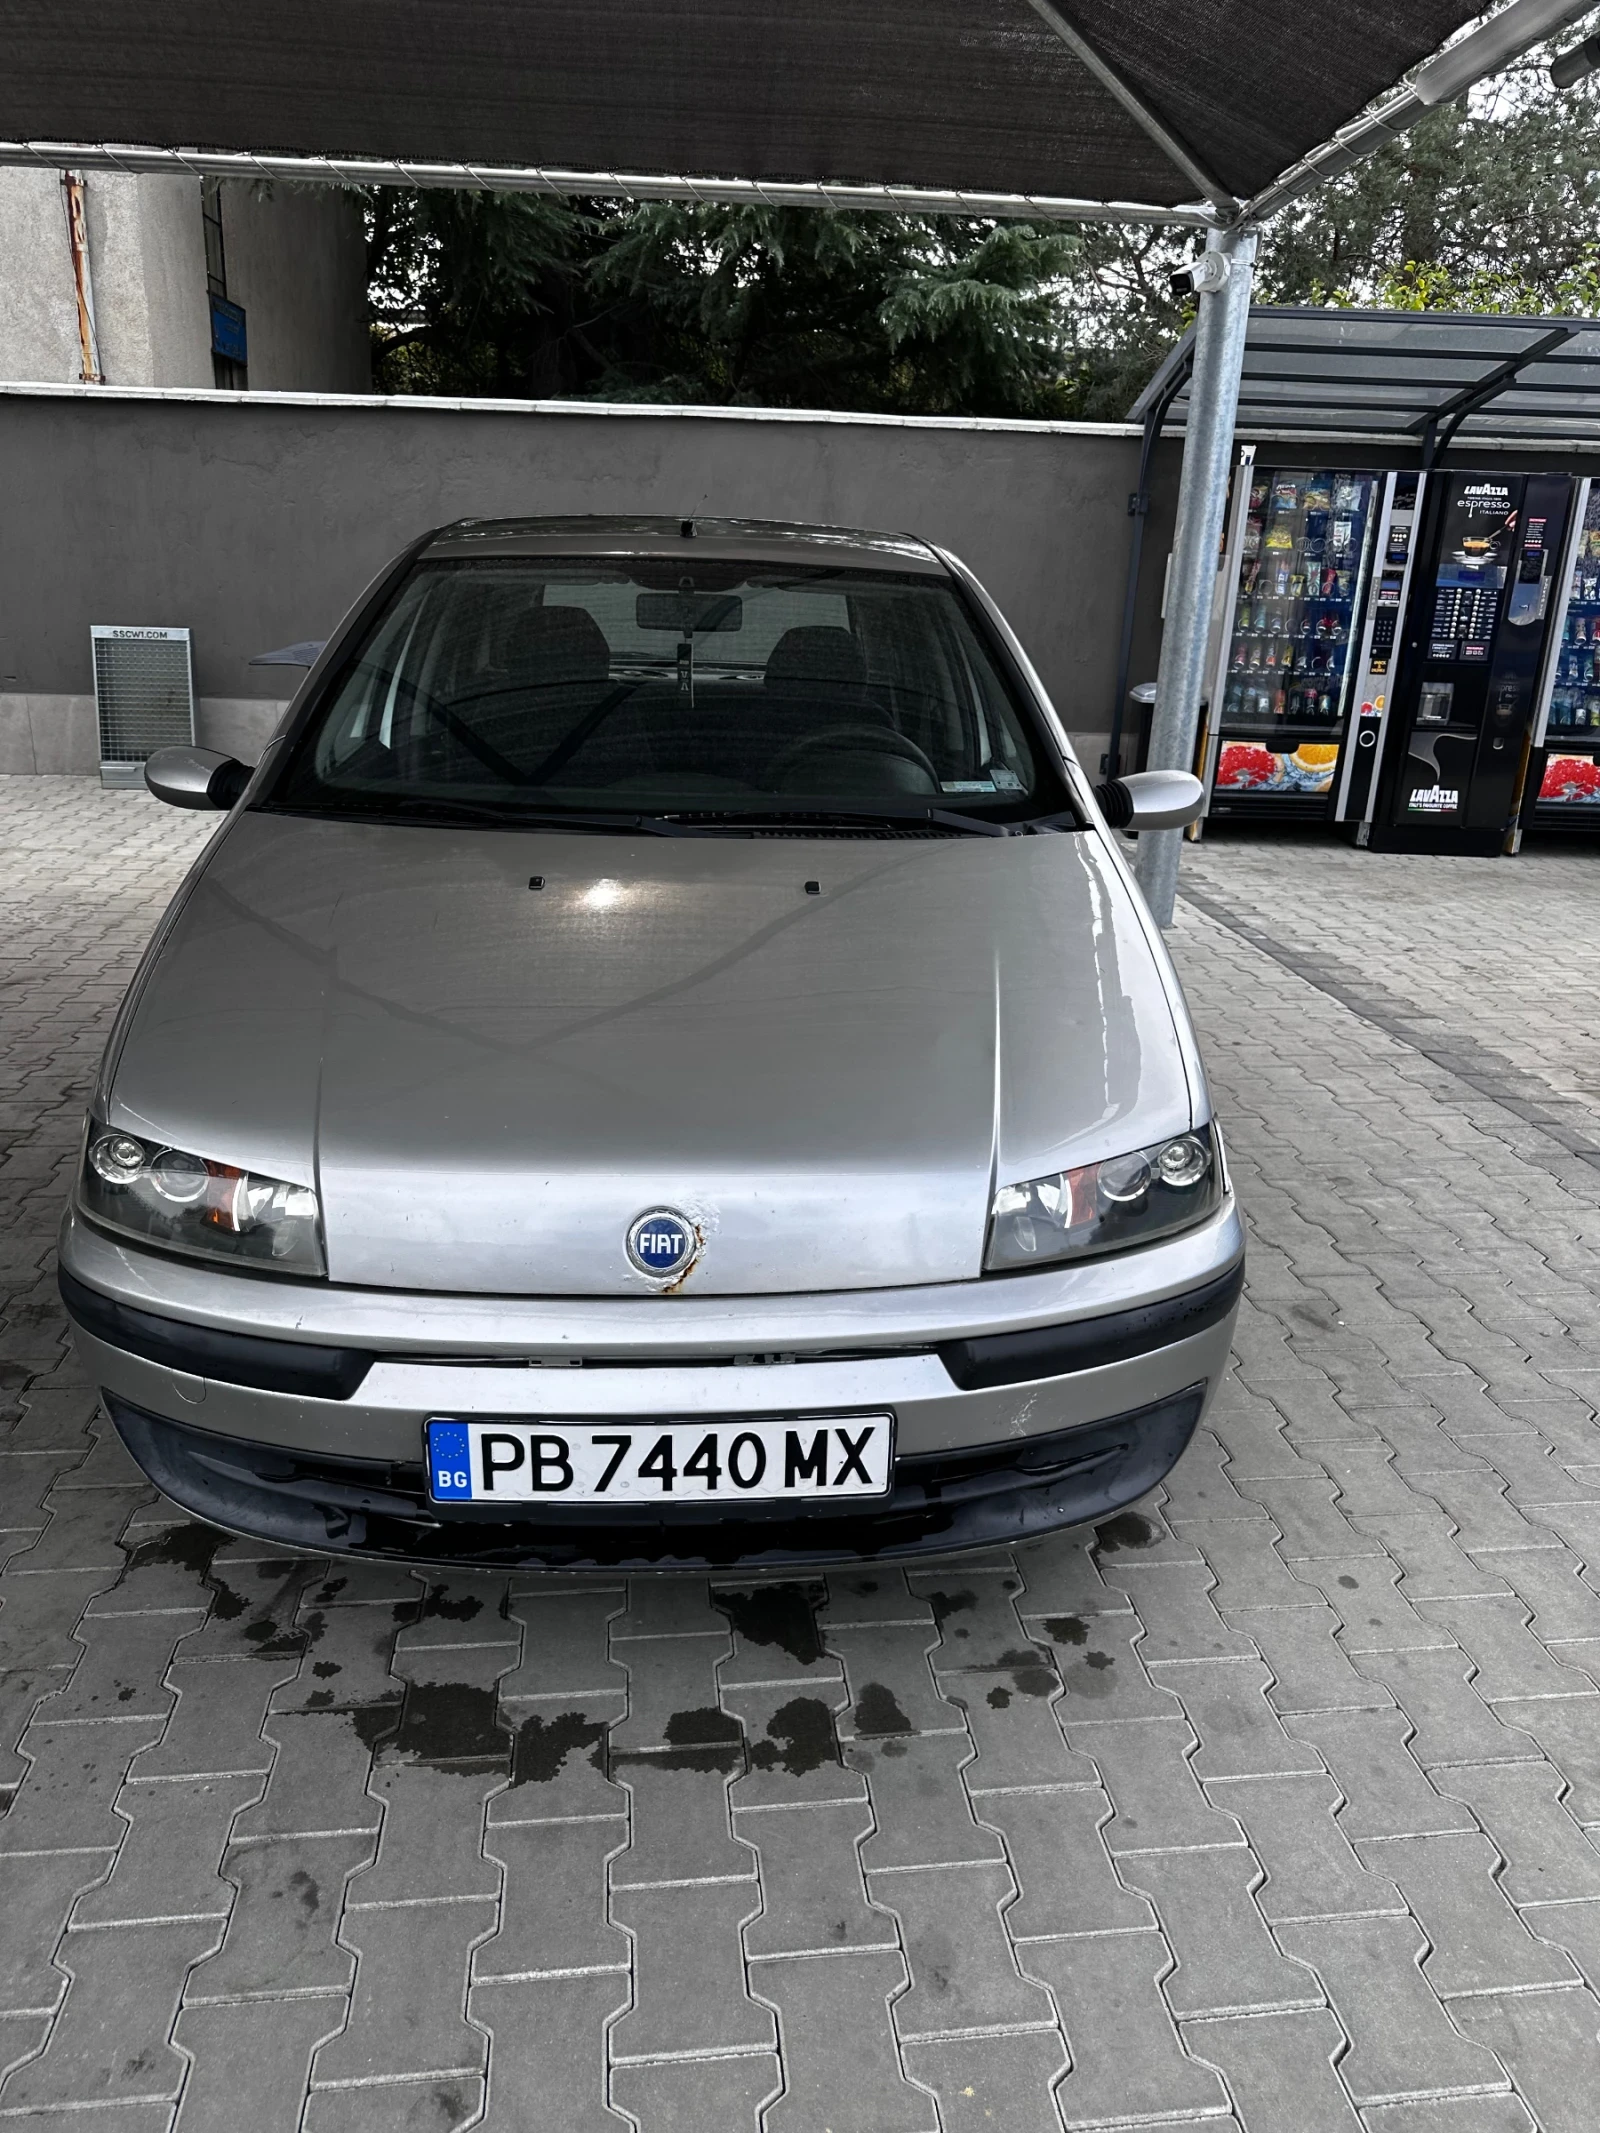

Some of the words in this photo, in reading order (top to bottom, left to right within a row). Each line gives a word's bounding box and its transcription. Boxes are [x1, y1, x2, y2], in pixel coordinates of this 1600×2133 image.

[1464, 483, 1508, 496] LAVAZZA
[1457, 500, 1511, 518] espresso
[1409, 785, 1459, 803] LAVAZZA
[640, 1233, 682, 1254] FIAT
[481, 1433, 574, 1492] PB
[591, 1431, 767, 1492] 7440
[784, 1427, 876, 1487] MX
[438, 1471, 468, 1488] BG
